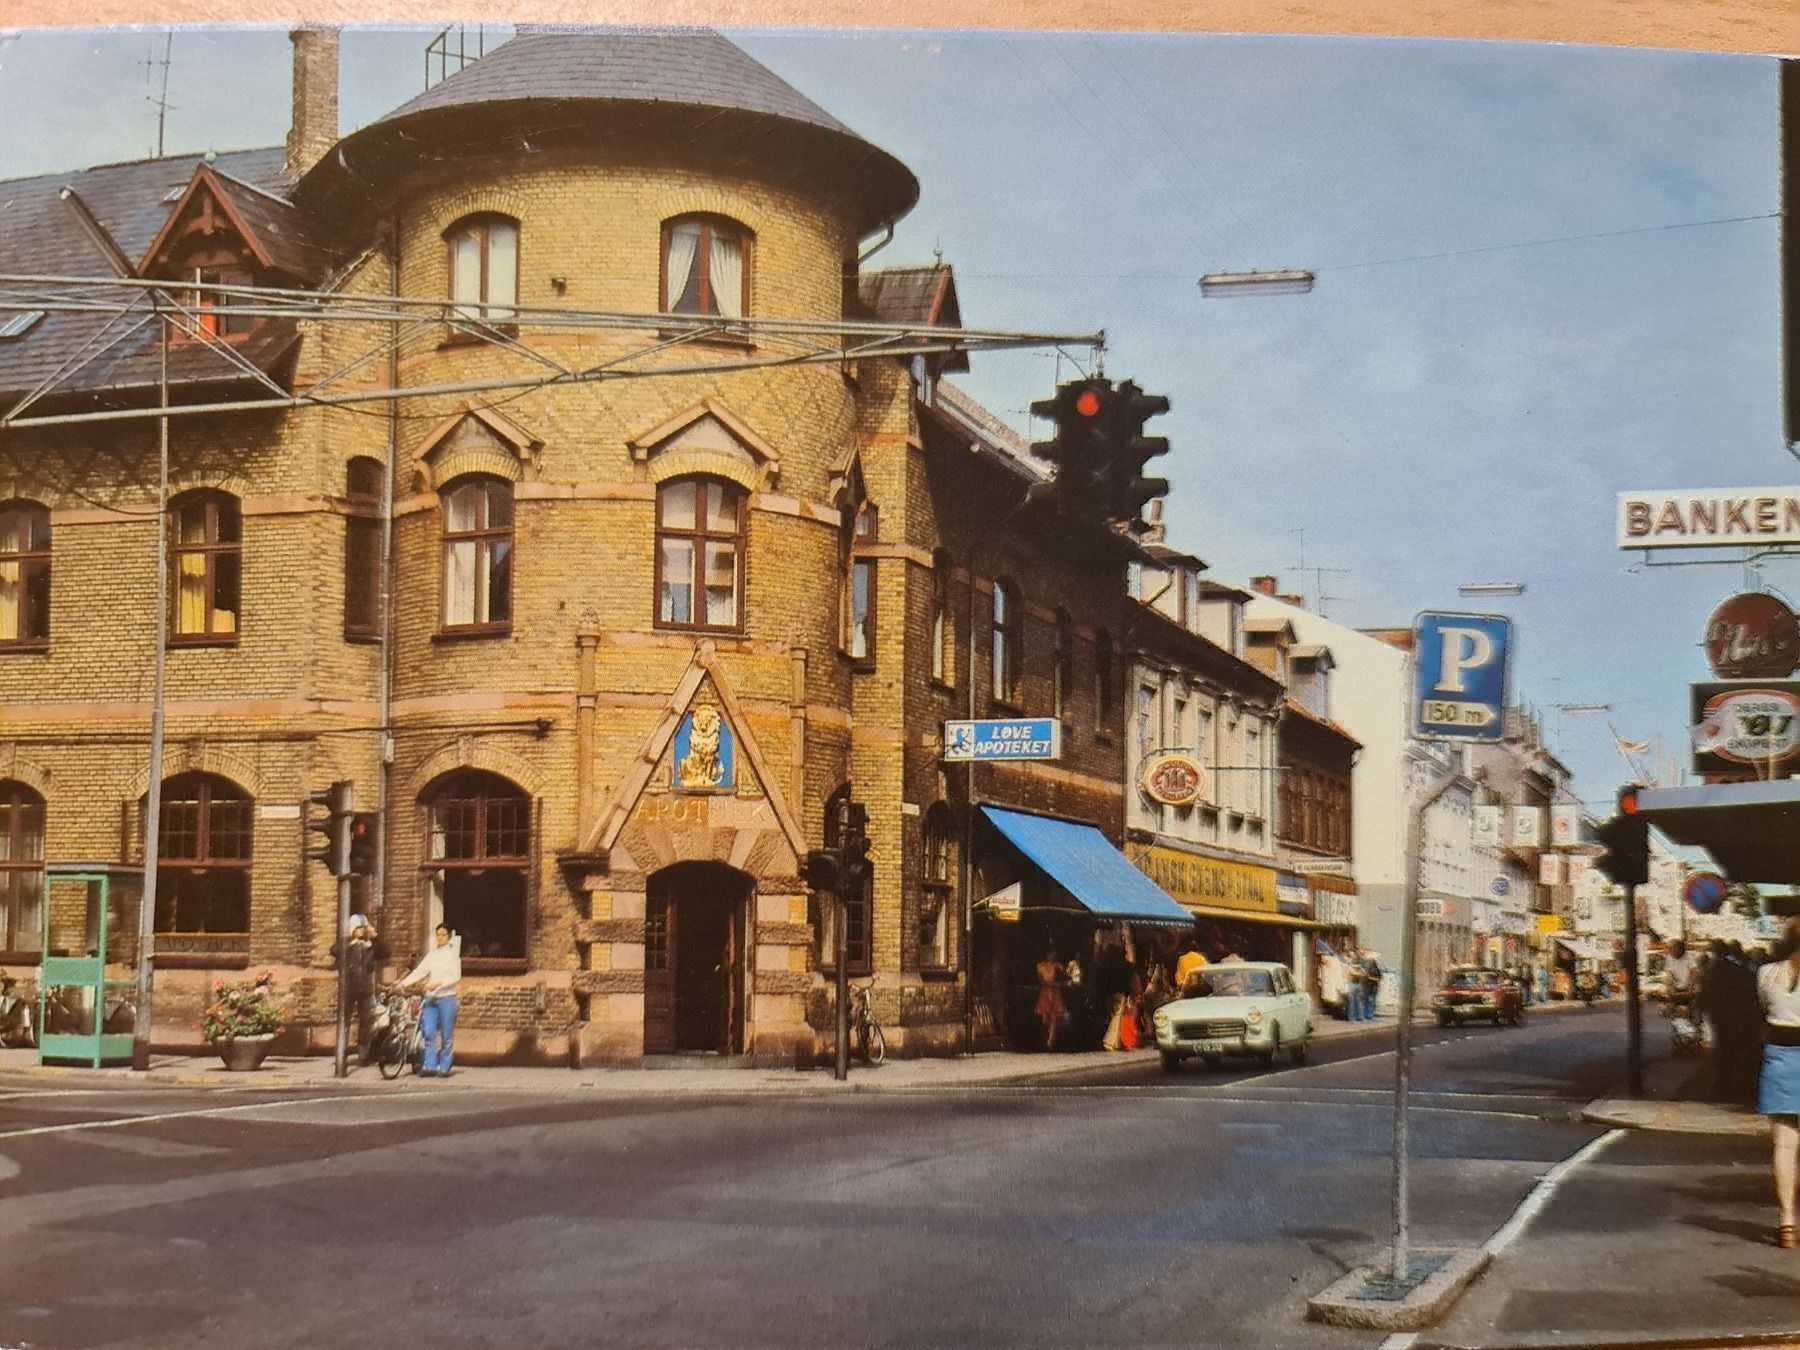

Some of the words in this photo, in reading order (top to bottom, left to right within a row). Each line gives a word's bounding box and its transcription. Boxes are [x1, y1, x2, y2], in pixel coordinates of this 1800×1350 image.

[1625, 497, 1800, 536] BANKEN
[1433, 626, 1490, 692] P
[1425, 702, 1457, 722] 150
[1464, 710, 1483, 724] m
[974, 740, 1051, 755] APOTEKET
